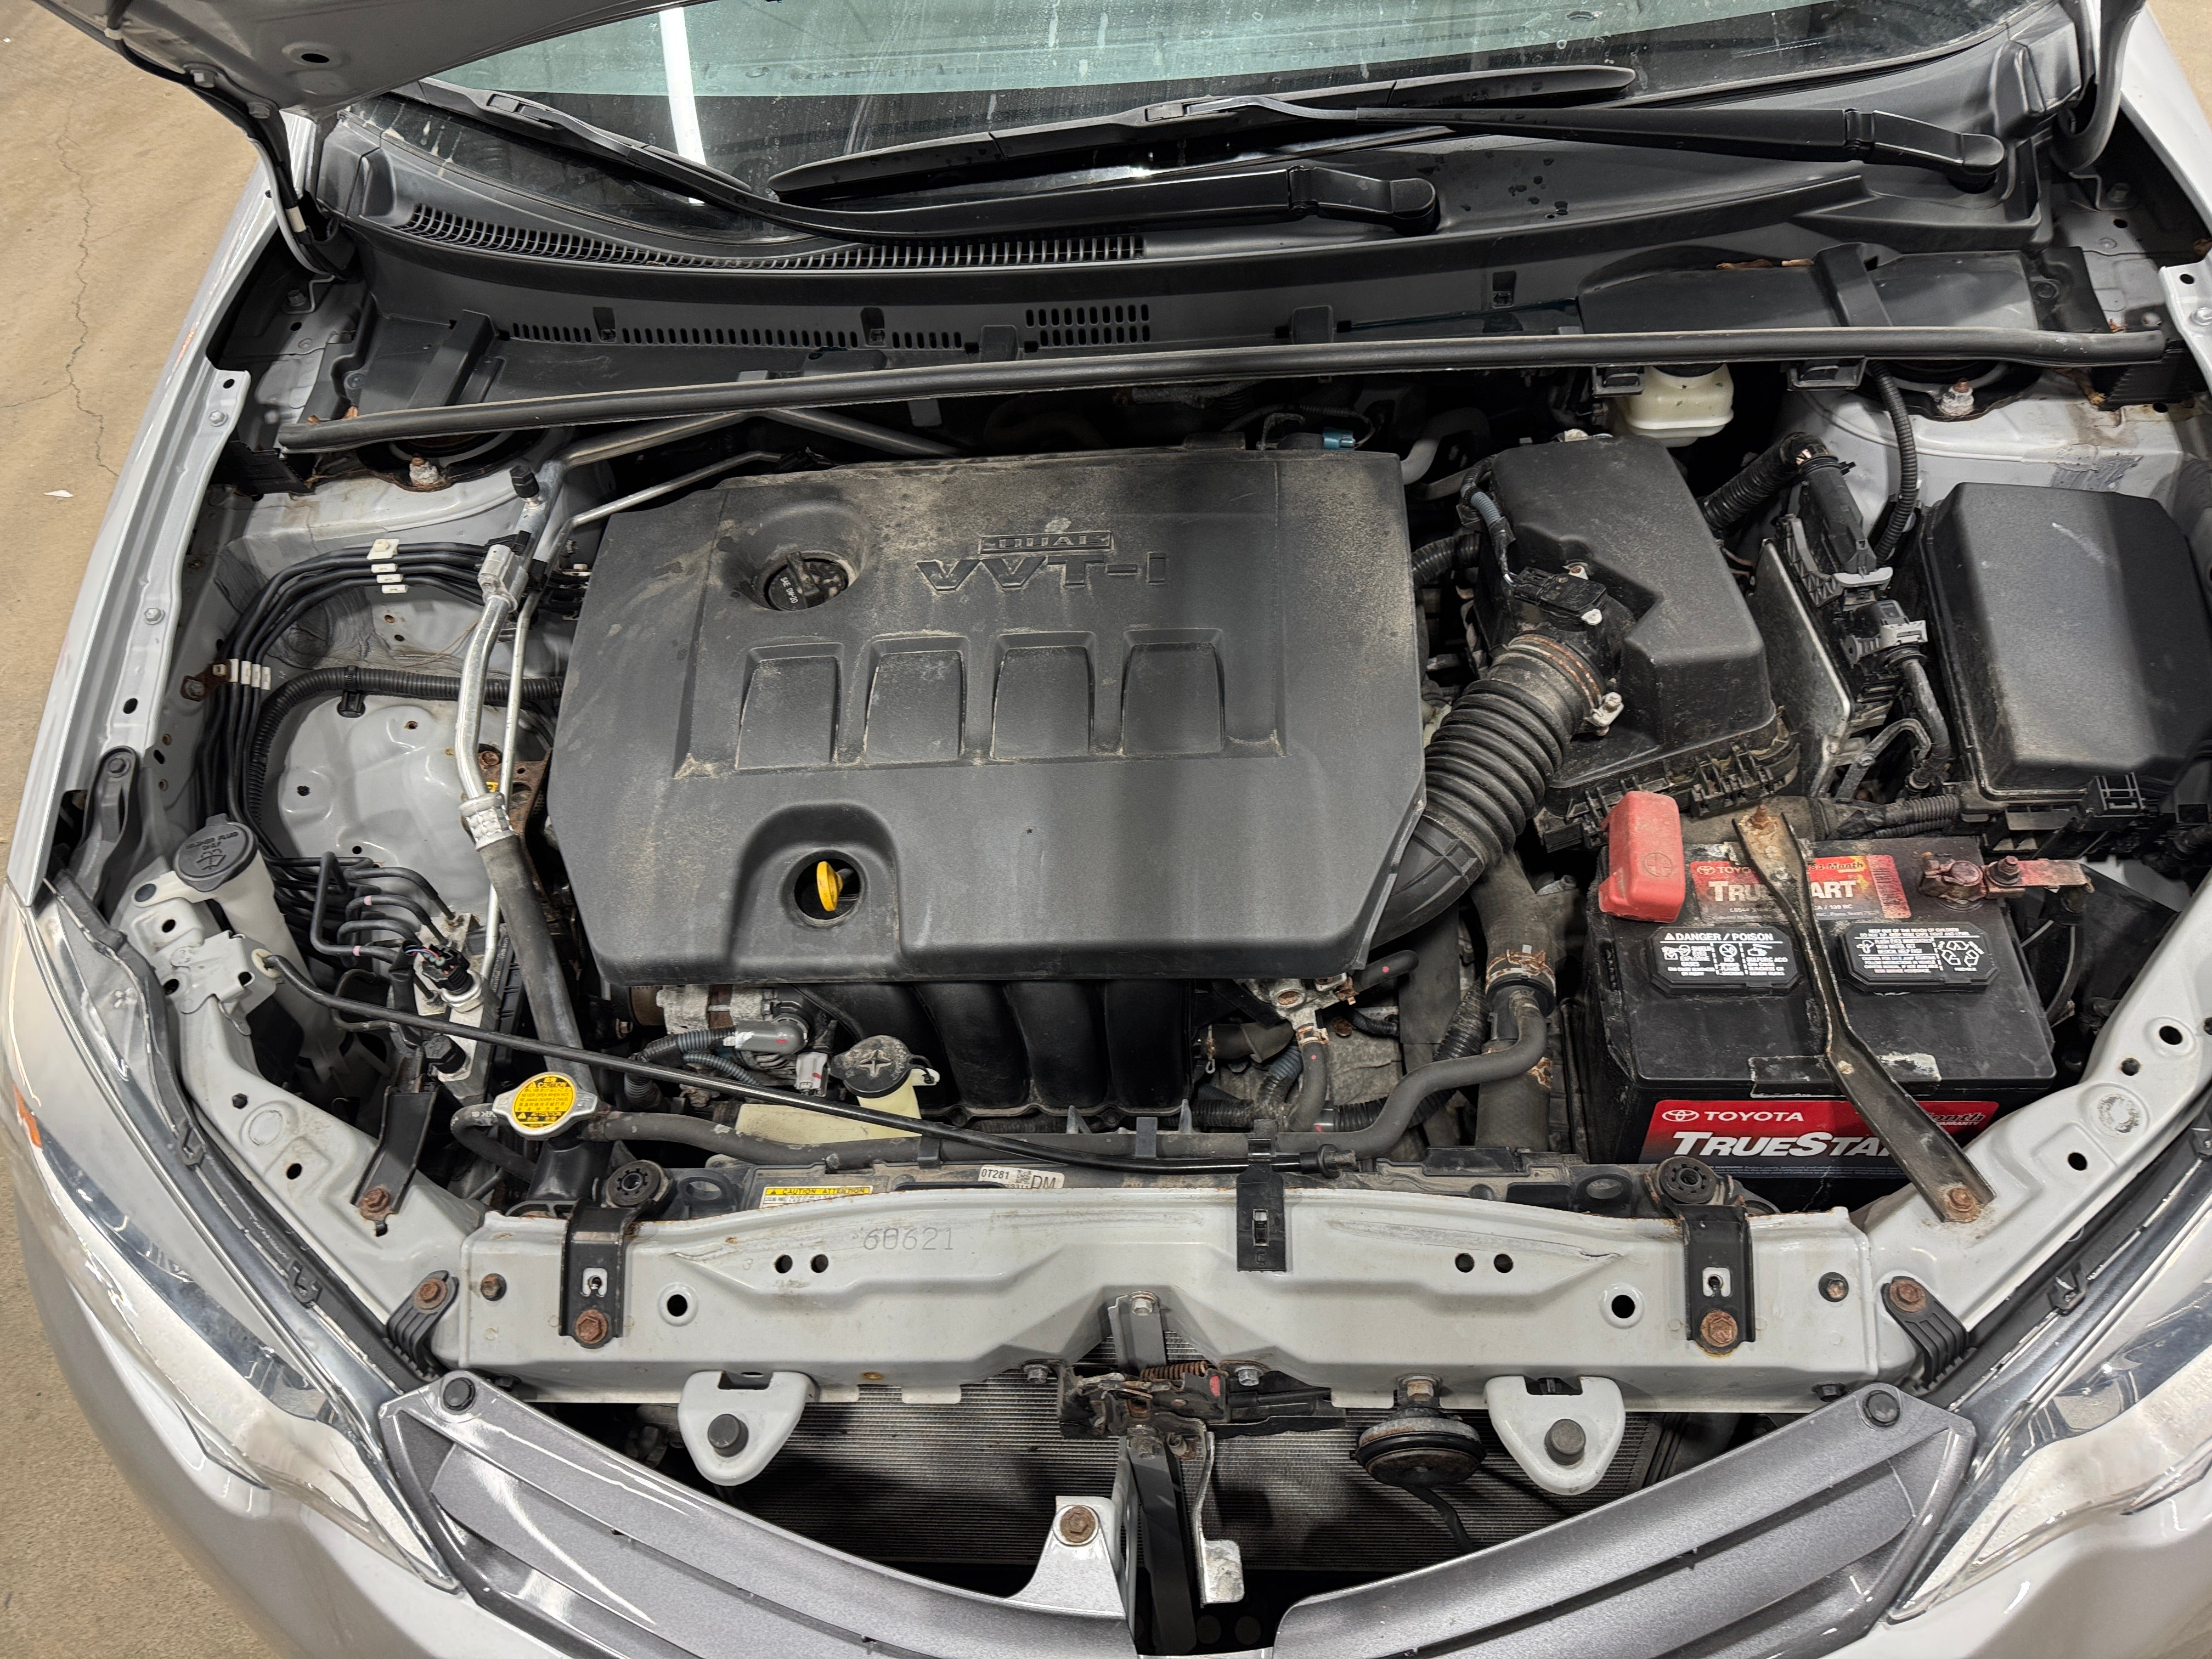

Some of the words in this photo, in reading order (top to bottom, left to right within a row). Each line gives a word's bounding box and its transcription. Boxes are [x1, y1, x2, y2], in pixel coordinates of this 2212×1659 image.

[998, 534, 1099, 548] DUAL
[780, 577, 791, 587] SAE
[1704, 1111, 1804, 1121] TOYOTA
[1031, 1175, 1057, 1189] DM
